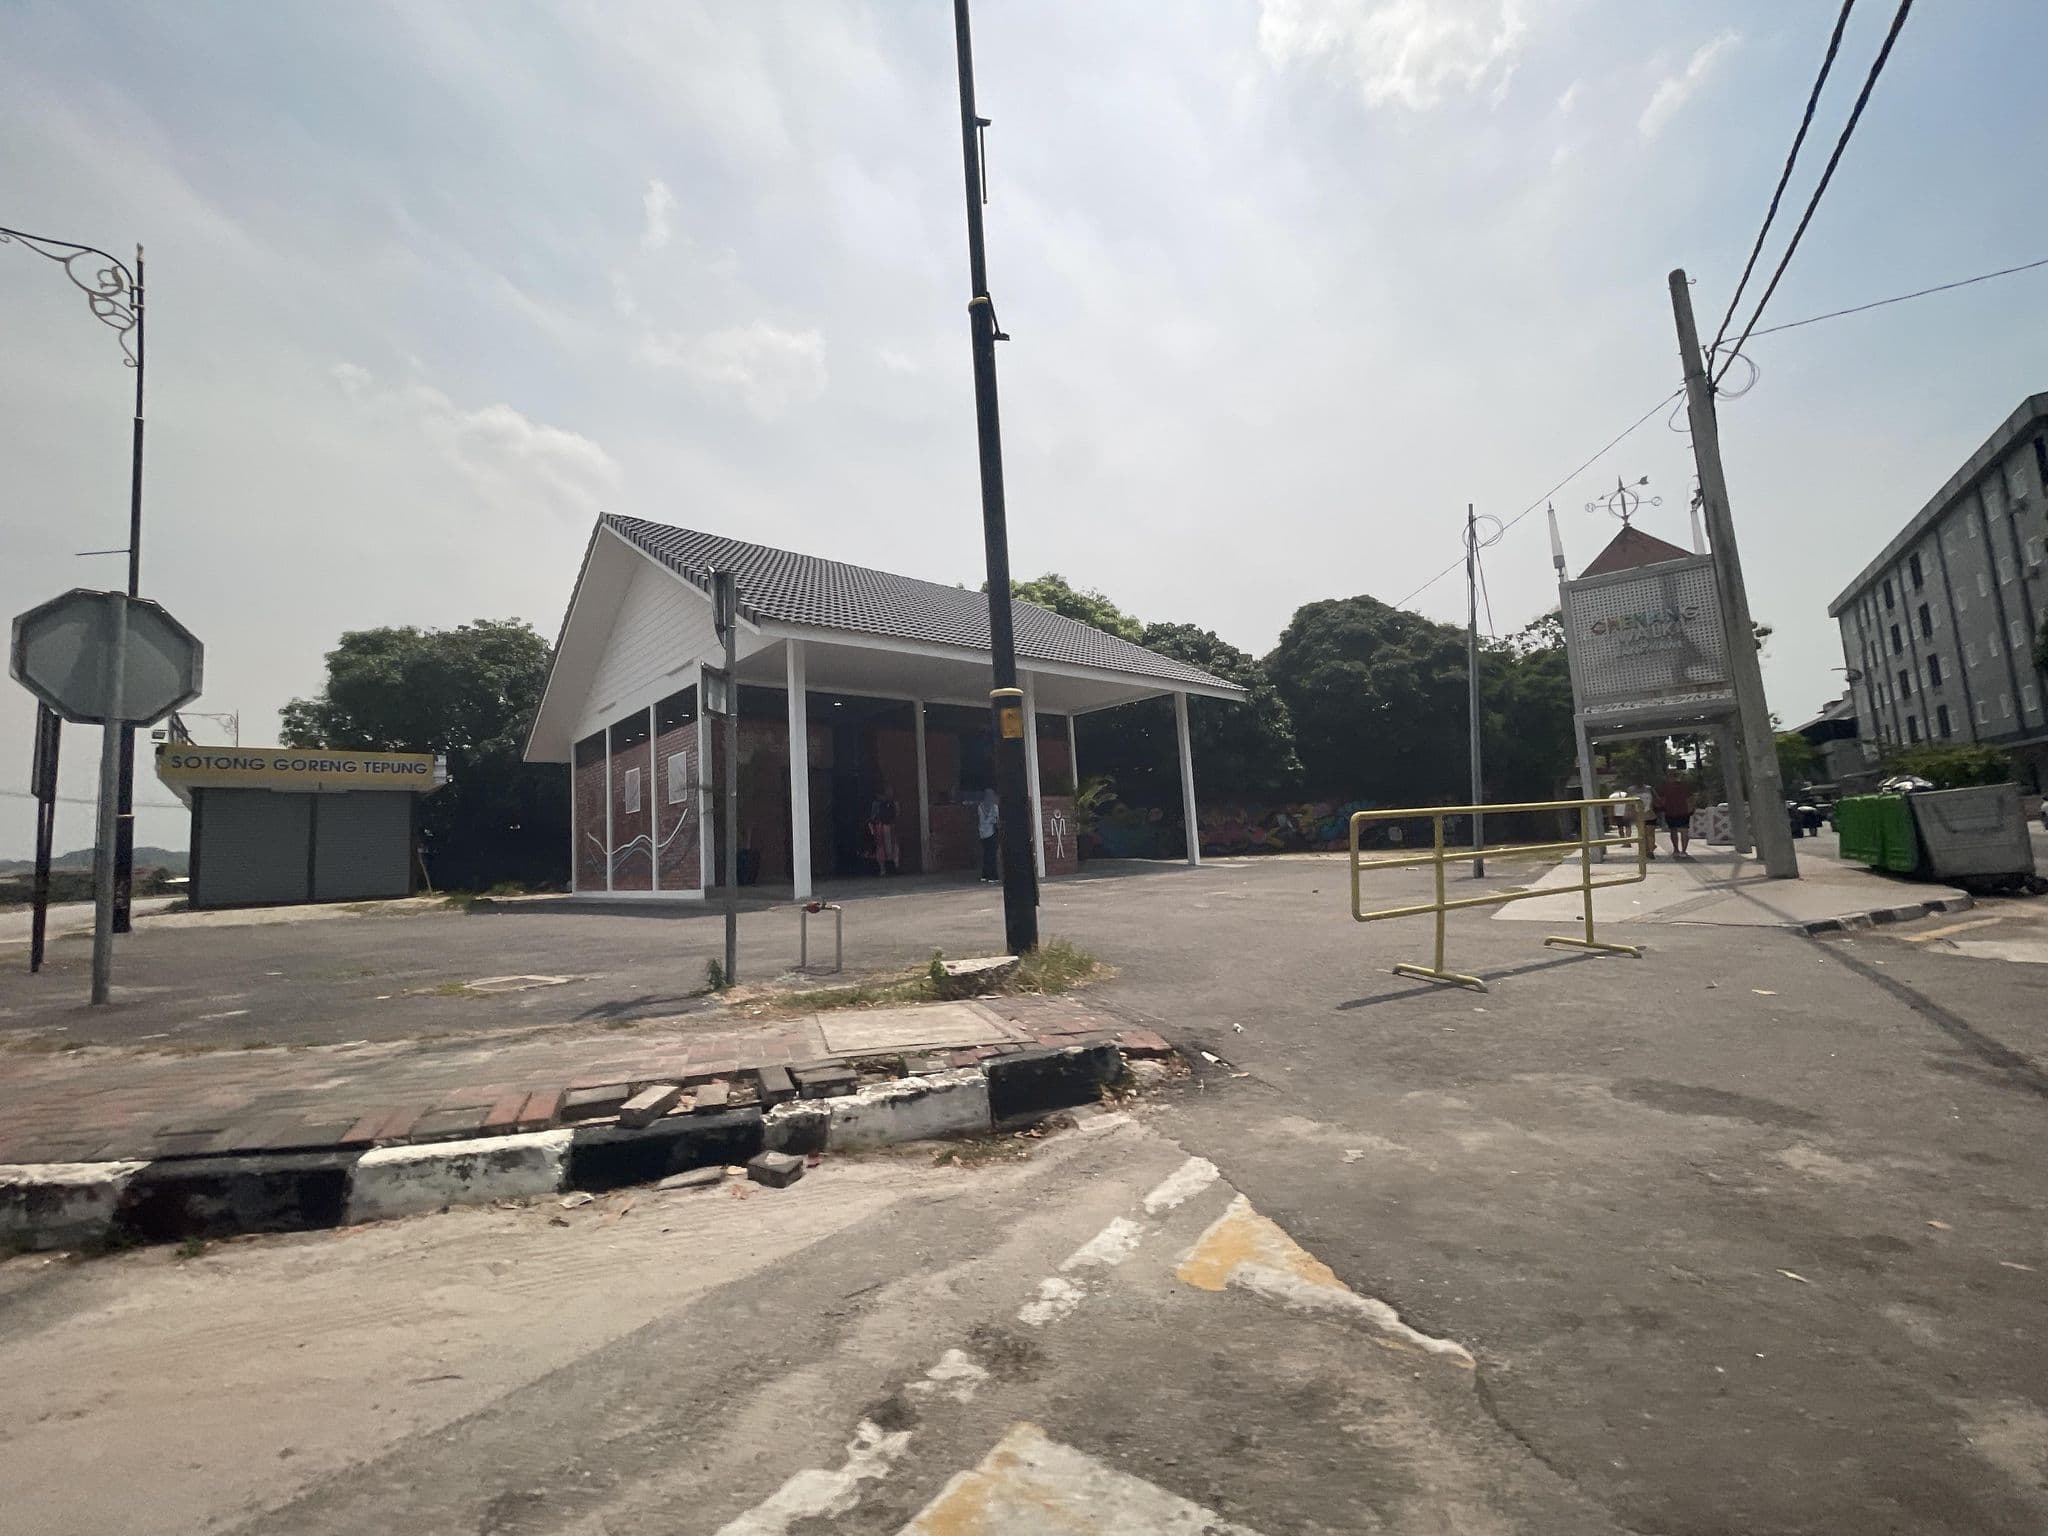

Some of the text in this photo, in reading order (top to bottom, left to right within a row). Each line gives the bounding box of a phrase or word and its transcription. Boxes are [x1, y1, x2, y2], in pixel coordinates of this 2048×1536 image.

[1591, 606, 1700, 635] CHENANG
[171, 755, 428, 775] SOTONG GORENG TEPUNG
